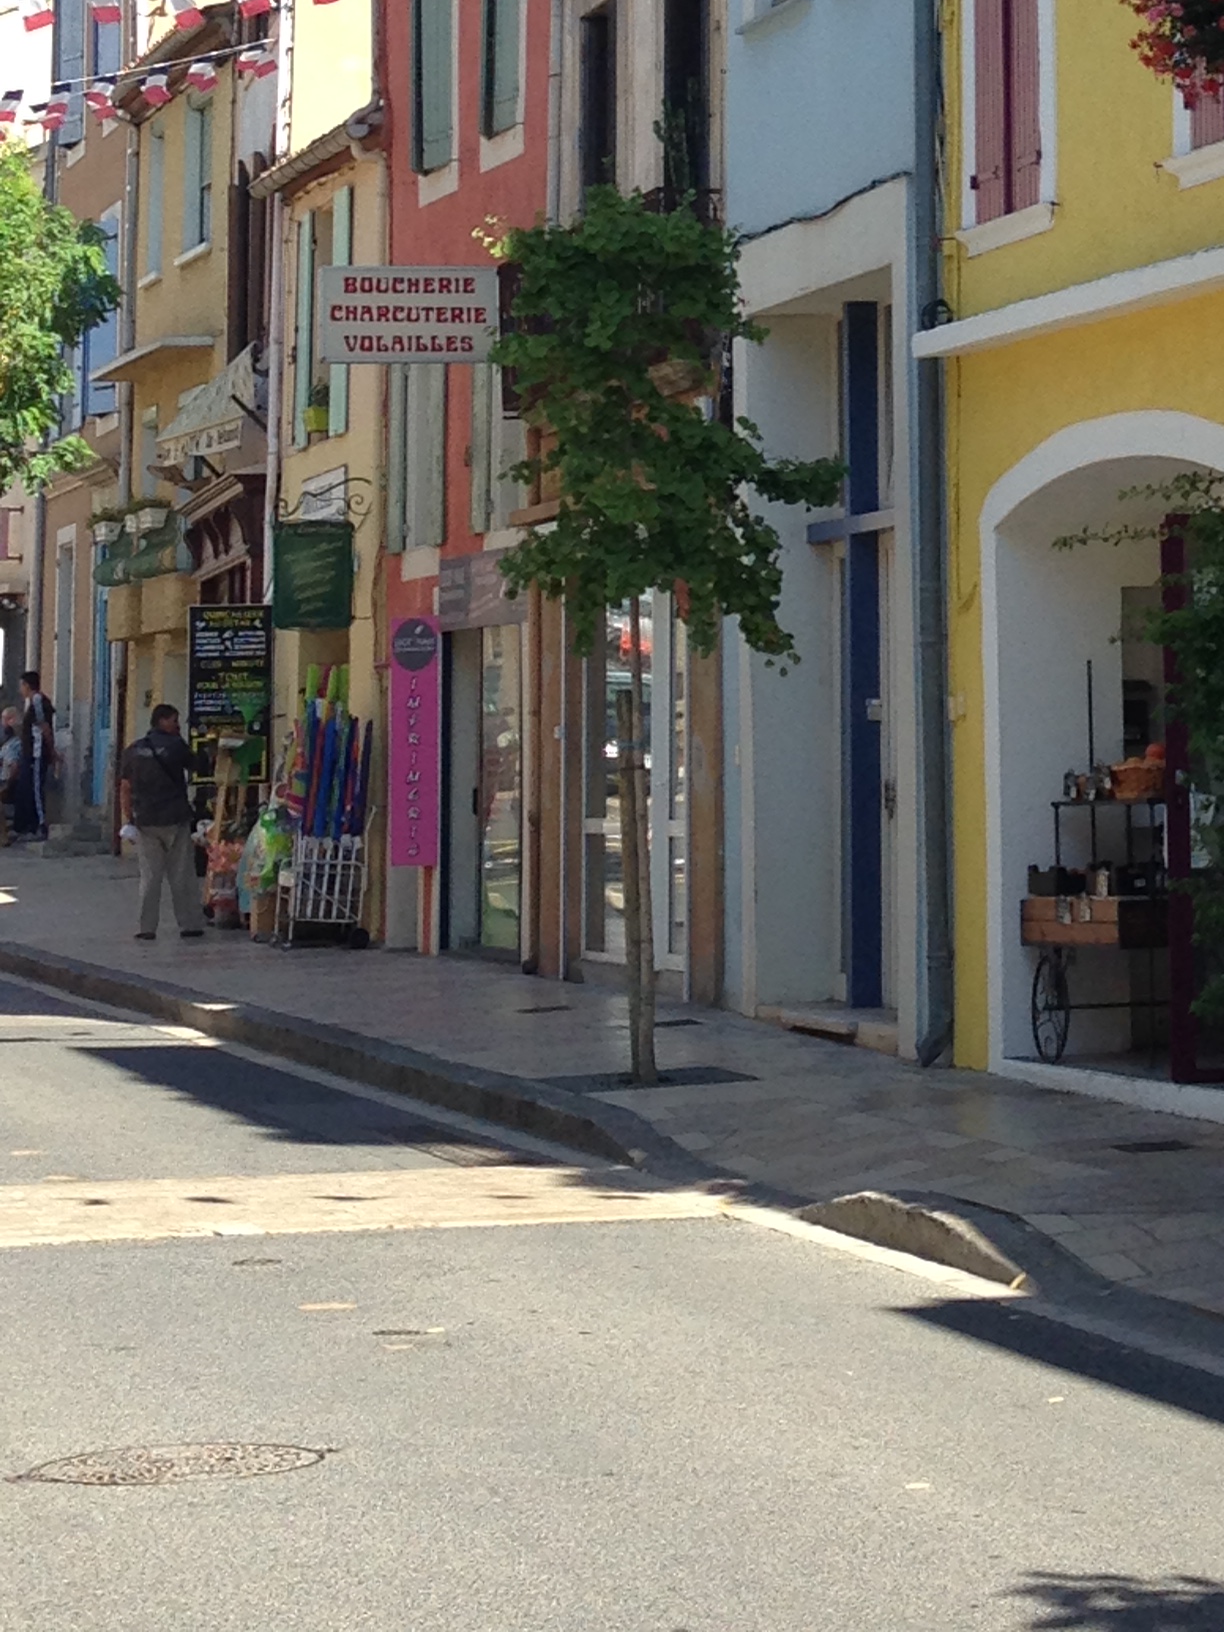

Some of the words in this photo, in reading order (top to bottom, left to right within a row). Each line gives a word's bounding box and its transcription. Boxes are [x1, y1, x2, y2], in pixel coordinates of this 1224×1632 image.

[344, 277, 476, 294] BOUCHERIE
[330, 305, 487, 324] CHARCUTERIE
[344, 335, 474, 352] VOLAILLES
